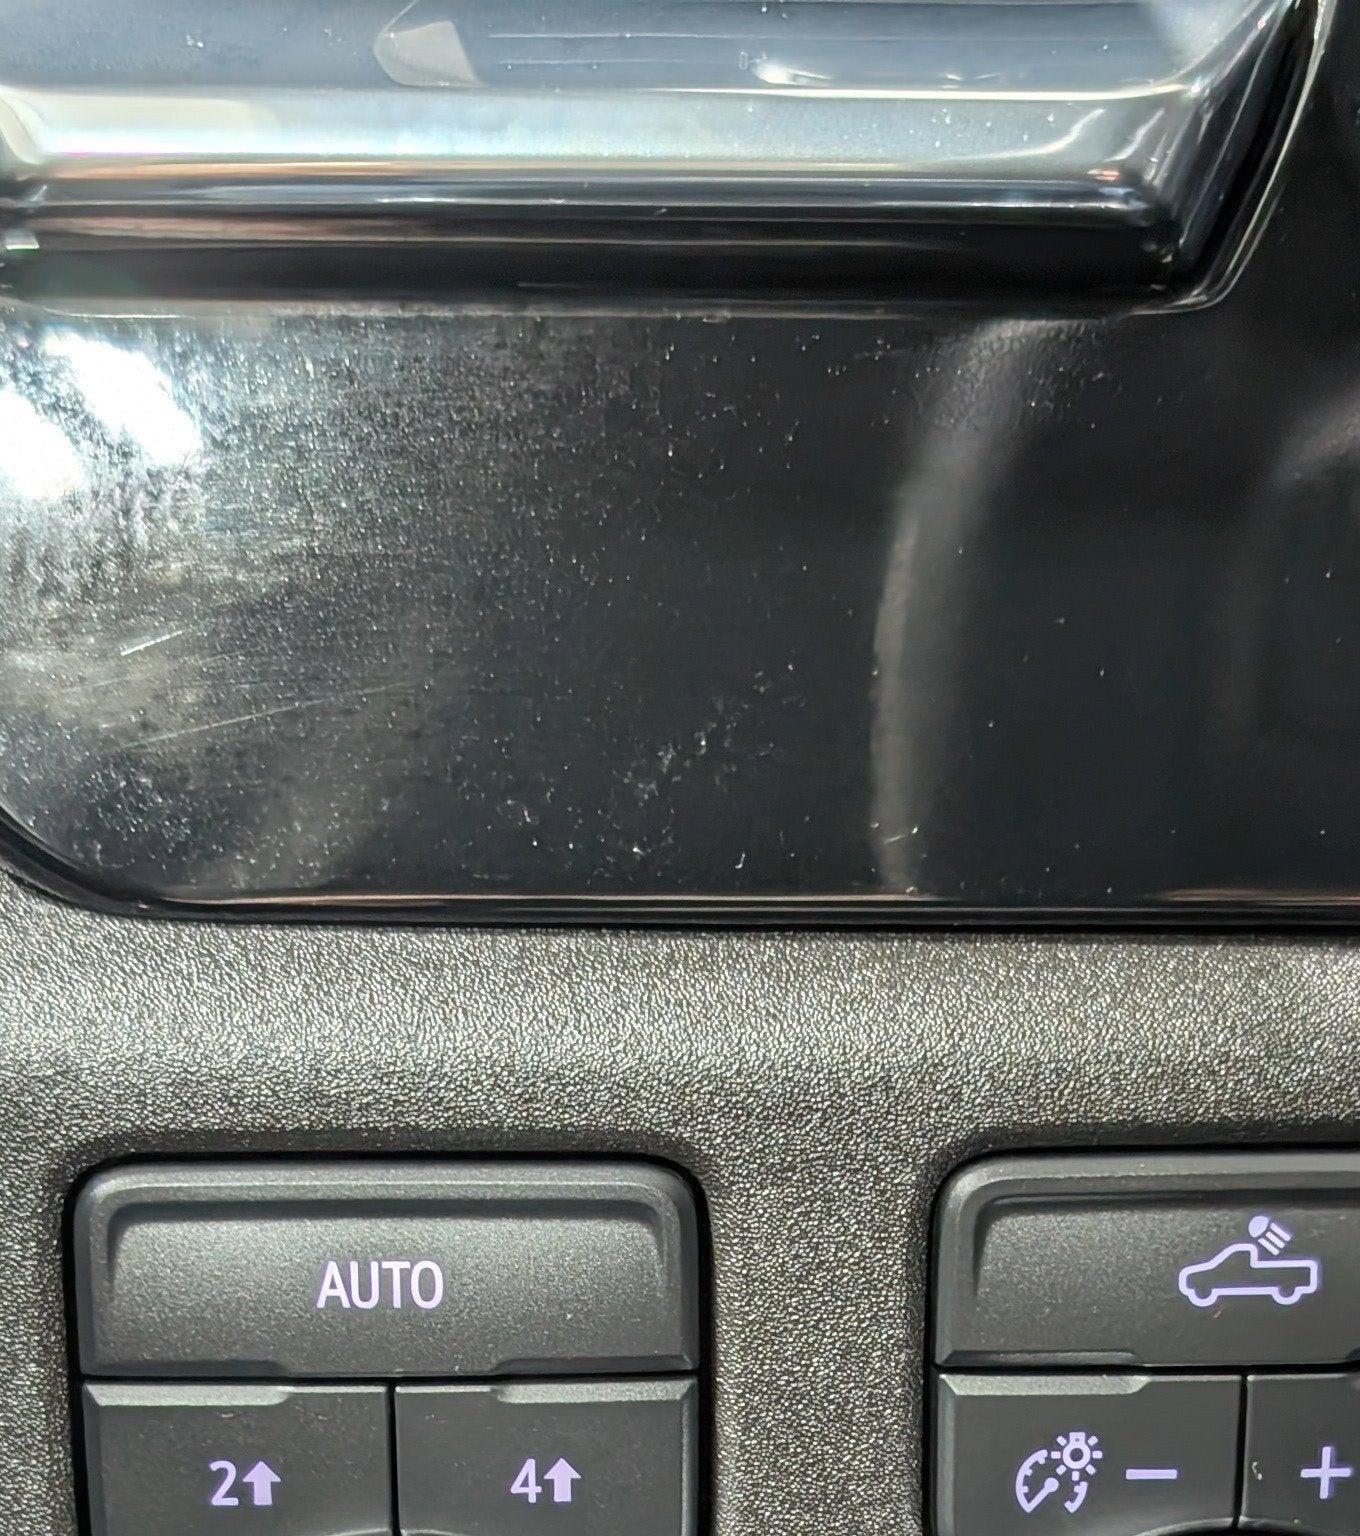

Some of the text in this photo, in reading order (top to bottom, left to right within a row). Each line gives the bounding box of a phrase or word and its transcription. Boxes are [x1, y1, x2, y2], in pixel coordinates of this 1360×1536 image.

[315, 1260, 444, 1310] AUTO
[208, 1459, 240, 1507] 2
[508, 1457, 542, 1504] 4
